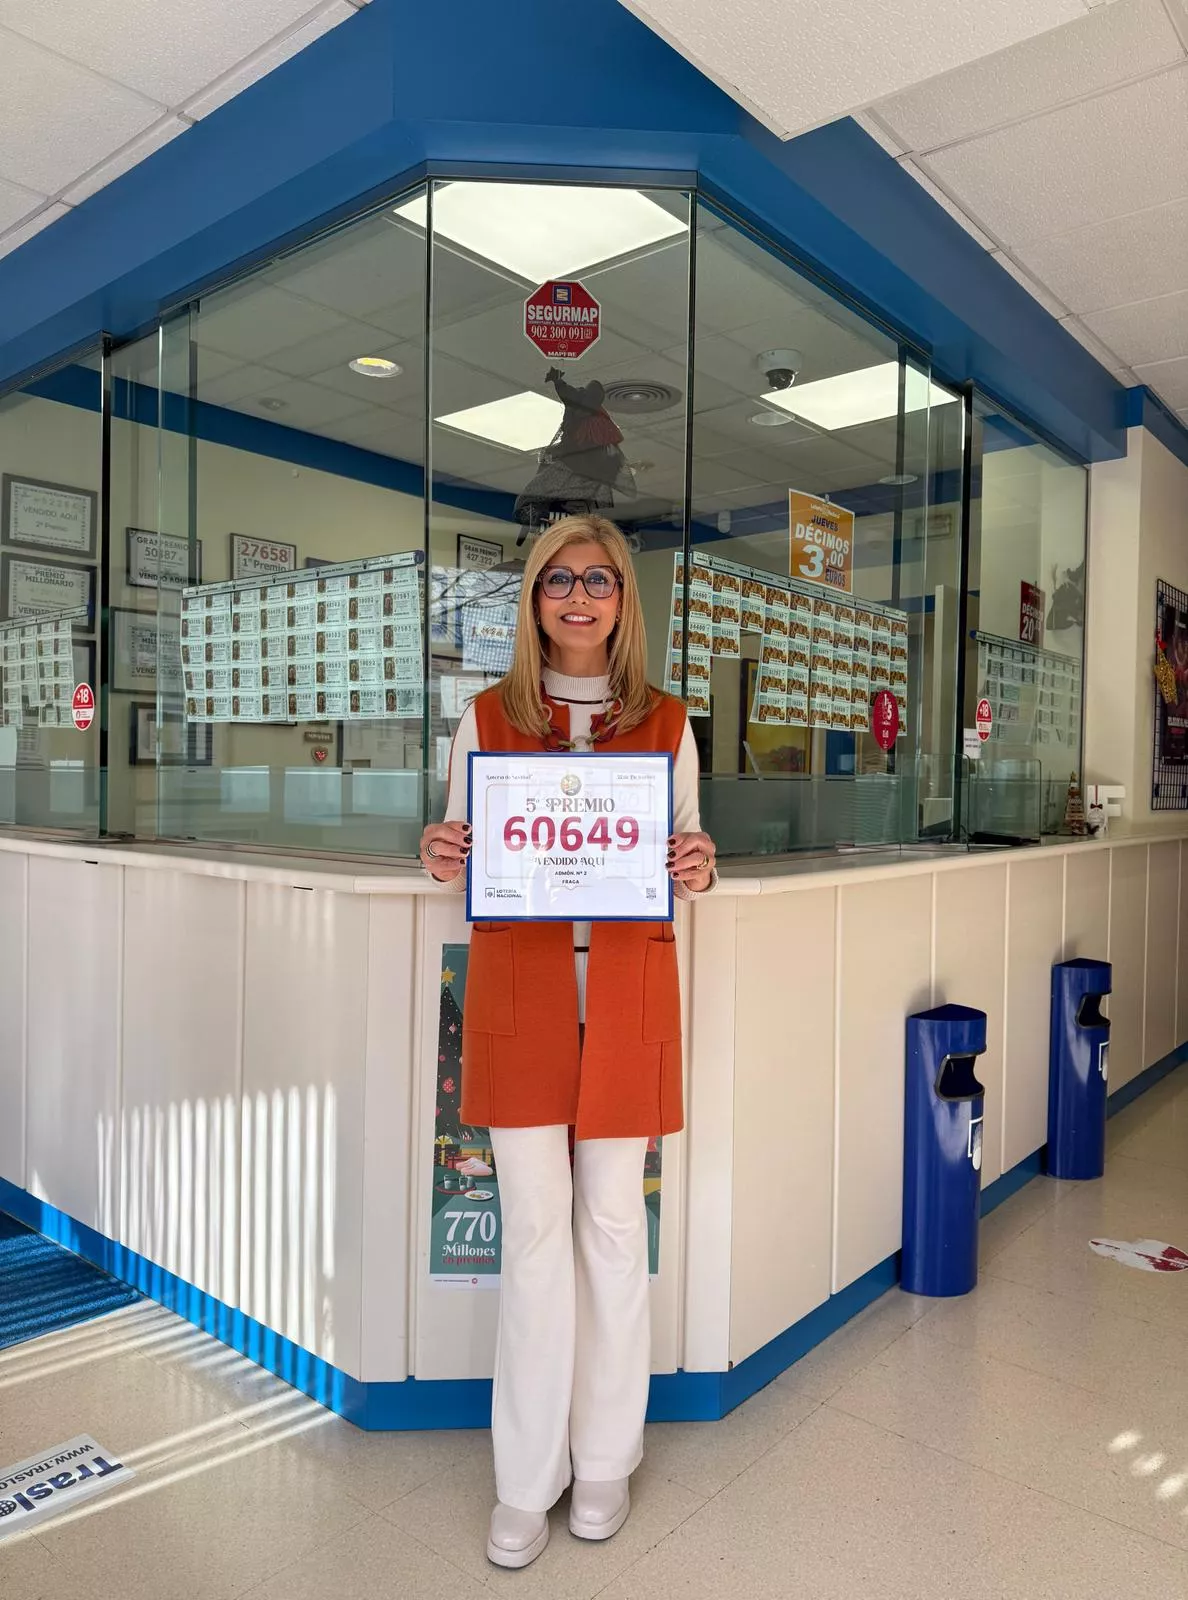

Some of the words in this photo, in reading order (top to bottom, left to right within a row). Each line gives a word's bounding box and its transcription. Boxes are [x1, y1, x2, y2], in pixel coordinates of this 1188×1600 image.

[527, 304, 598, 322] SEGURMAP
[531, 325, 548, 338] 902
[550, 326, 567, 339] 300
[568, 327, 584, 339] 091
[811, 515, 839, 532] JUEVES
[795, 523, 850, 555] DÉCIMOS
[240, 541, 289, 563] 27658
[25, 575, 75, 588] MILLONARIO
[35, 569, 66, 580] PREMIO
[824, 567, 846, 587] EUROS
[76, 688, 89, 704] +18
[979, 703, 989, 717] +18
[546, 797, 616, 813] PREMIO
[503, 815, 640, 852] 60649
[533, 857, 578, 866] VENDIDO
[444, 1211, 497, 1242] 770
[442, 1242, 496, 1257] Millones
